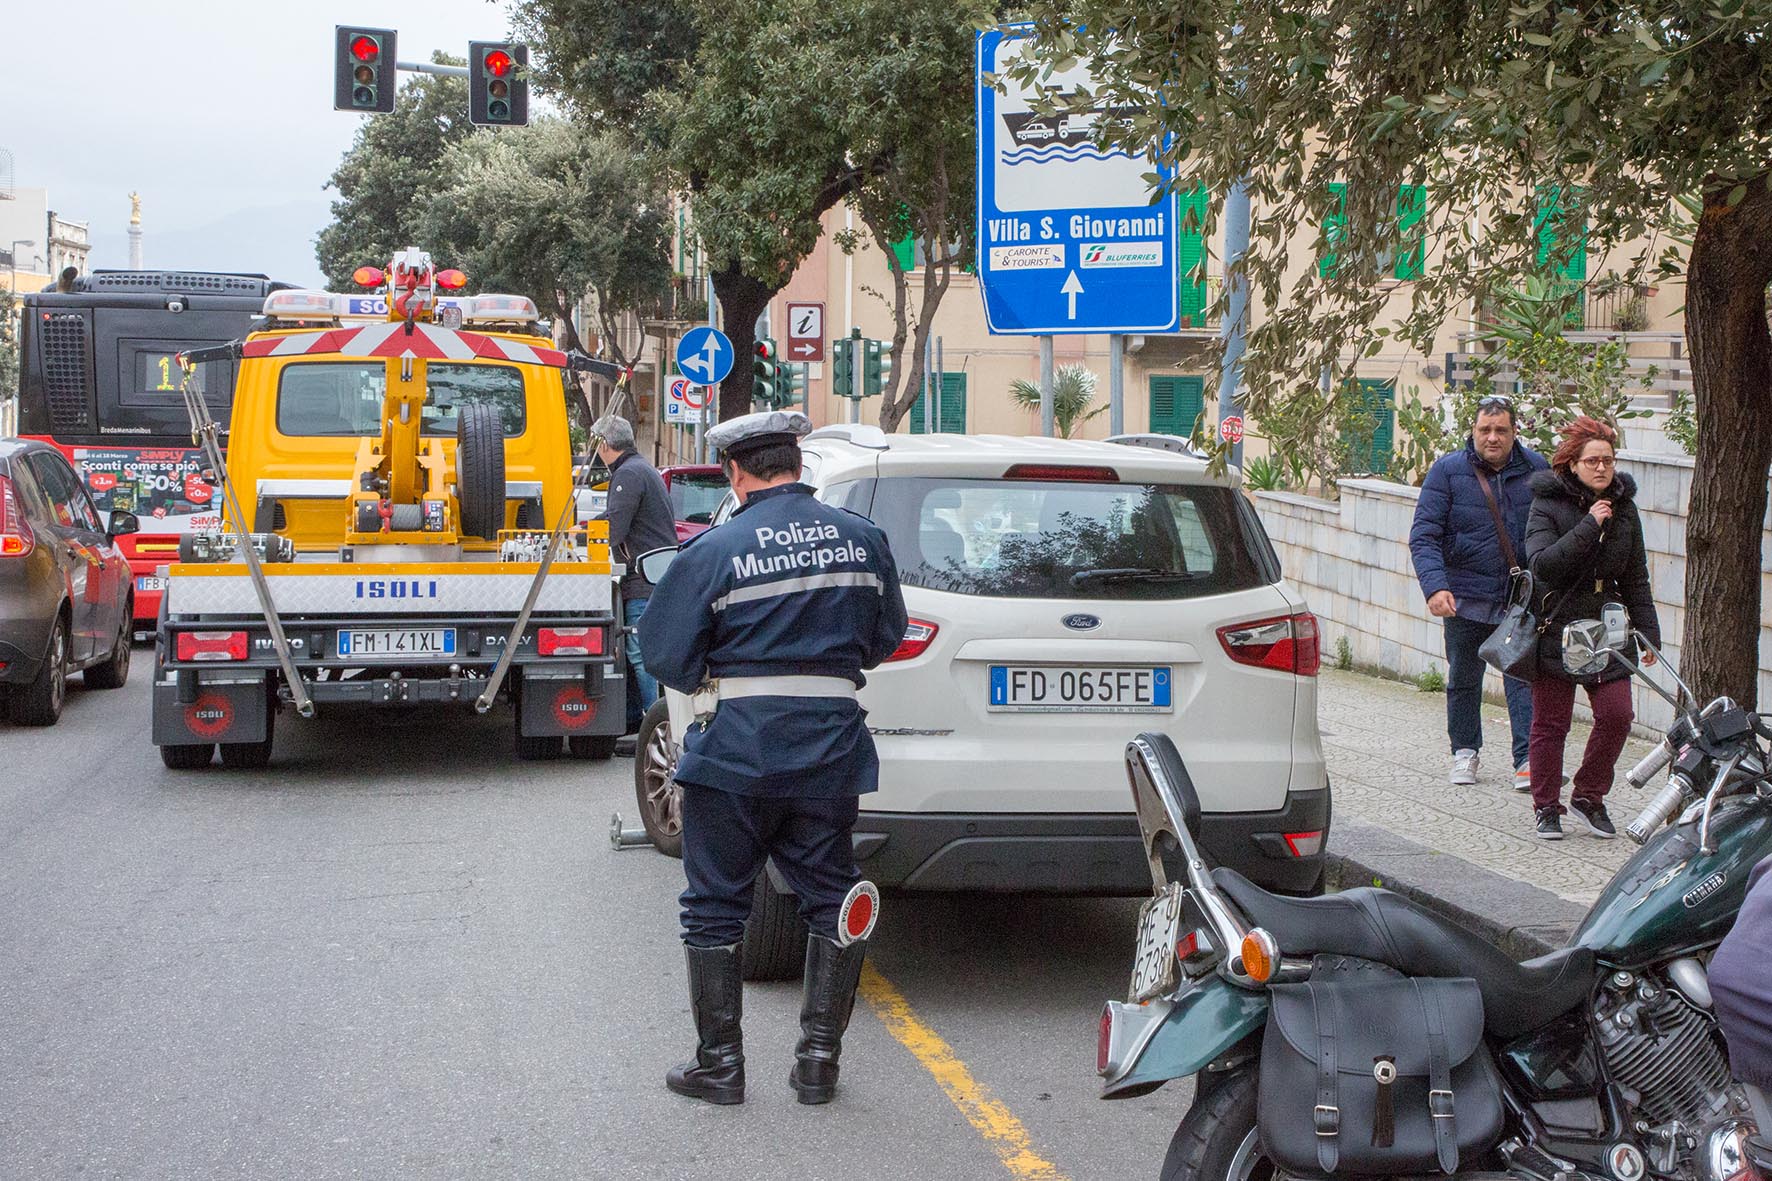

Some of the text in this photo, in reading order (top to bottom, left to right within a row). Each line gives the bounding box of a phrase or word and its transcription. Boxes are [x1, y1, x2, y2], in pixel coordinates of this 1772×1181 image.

[988, 213, 1164, 242] Villa S. Giovanni
[1007, 247, 1050, 257] CARONTE
[1105, 253, 1157, 262] BLUFERRIES
[1002, 257, 1050, 267] & TOURIST
[81, 460, 121, 471] Sconti
[124, 462, 157, 471] come
[160, 463, 174, 471] se
[755, 520, 839, 549] Polizia
[732, 540, 867, 579] Municipale
[145, 578, 159, 590] FB
[356, 581, 438, 599] ISOLI
[1070, 616, 1093, 627] Ford
[255, 638, 304, 650] IVO
[353, 632, 378, 651] FM
[383, 632, 441, 652] 141XL
[1012, 671, 1046, 702] FD
[1060, 671, 1151, 702] 065FE
[562, 703, 588, 711] ISOLI
[196, 710, 224, 719] ISOLI
[1687, 875, 1723, 904] YAMAHA
